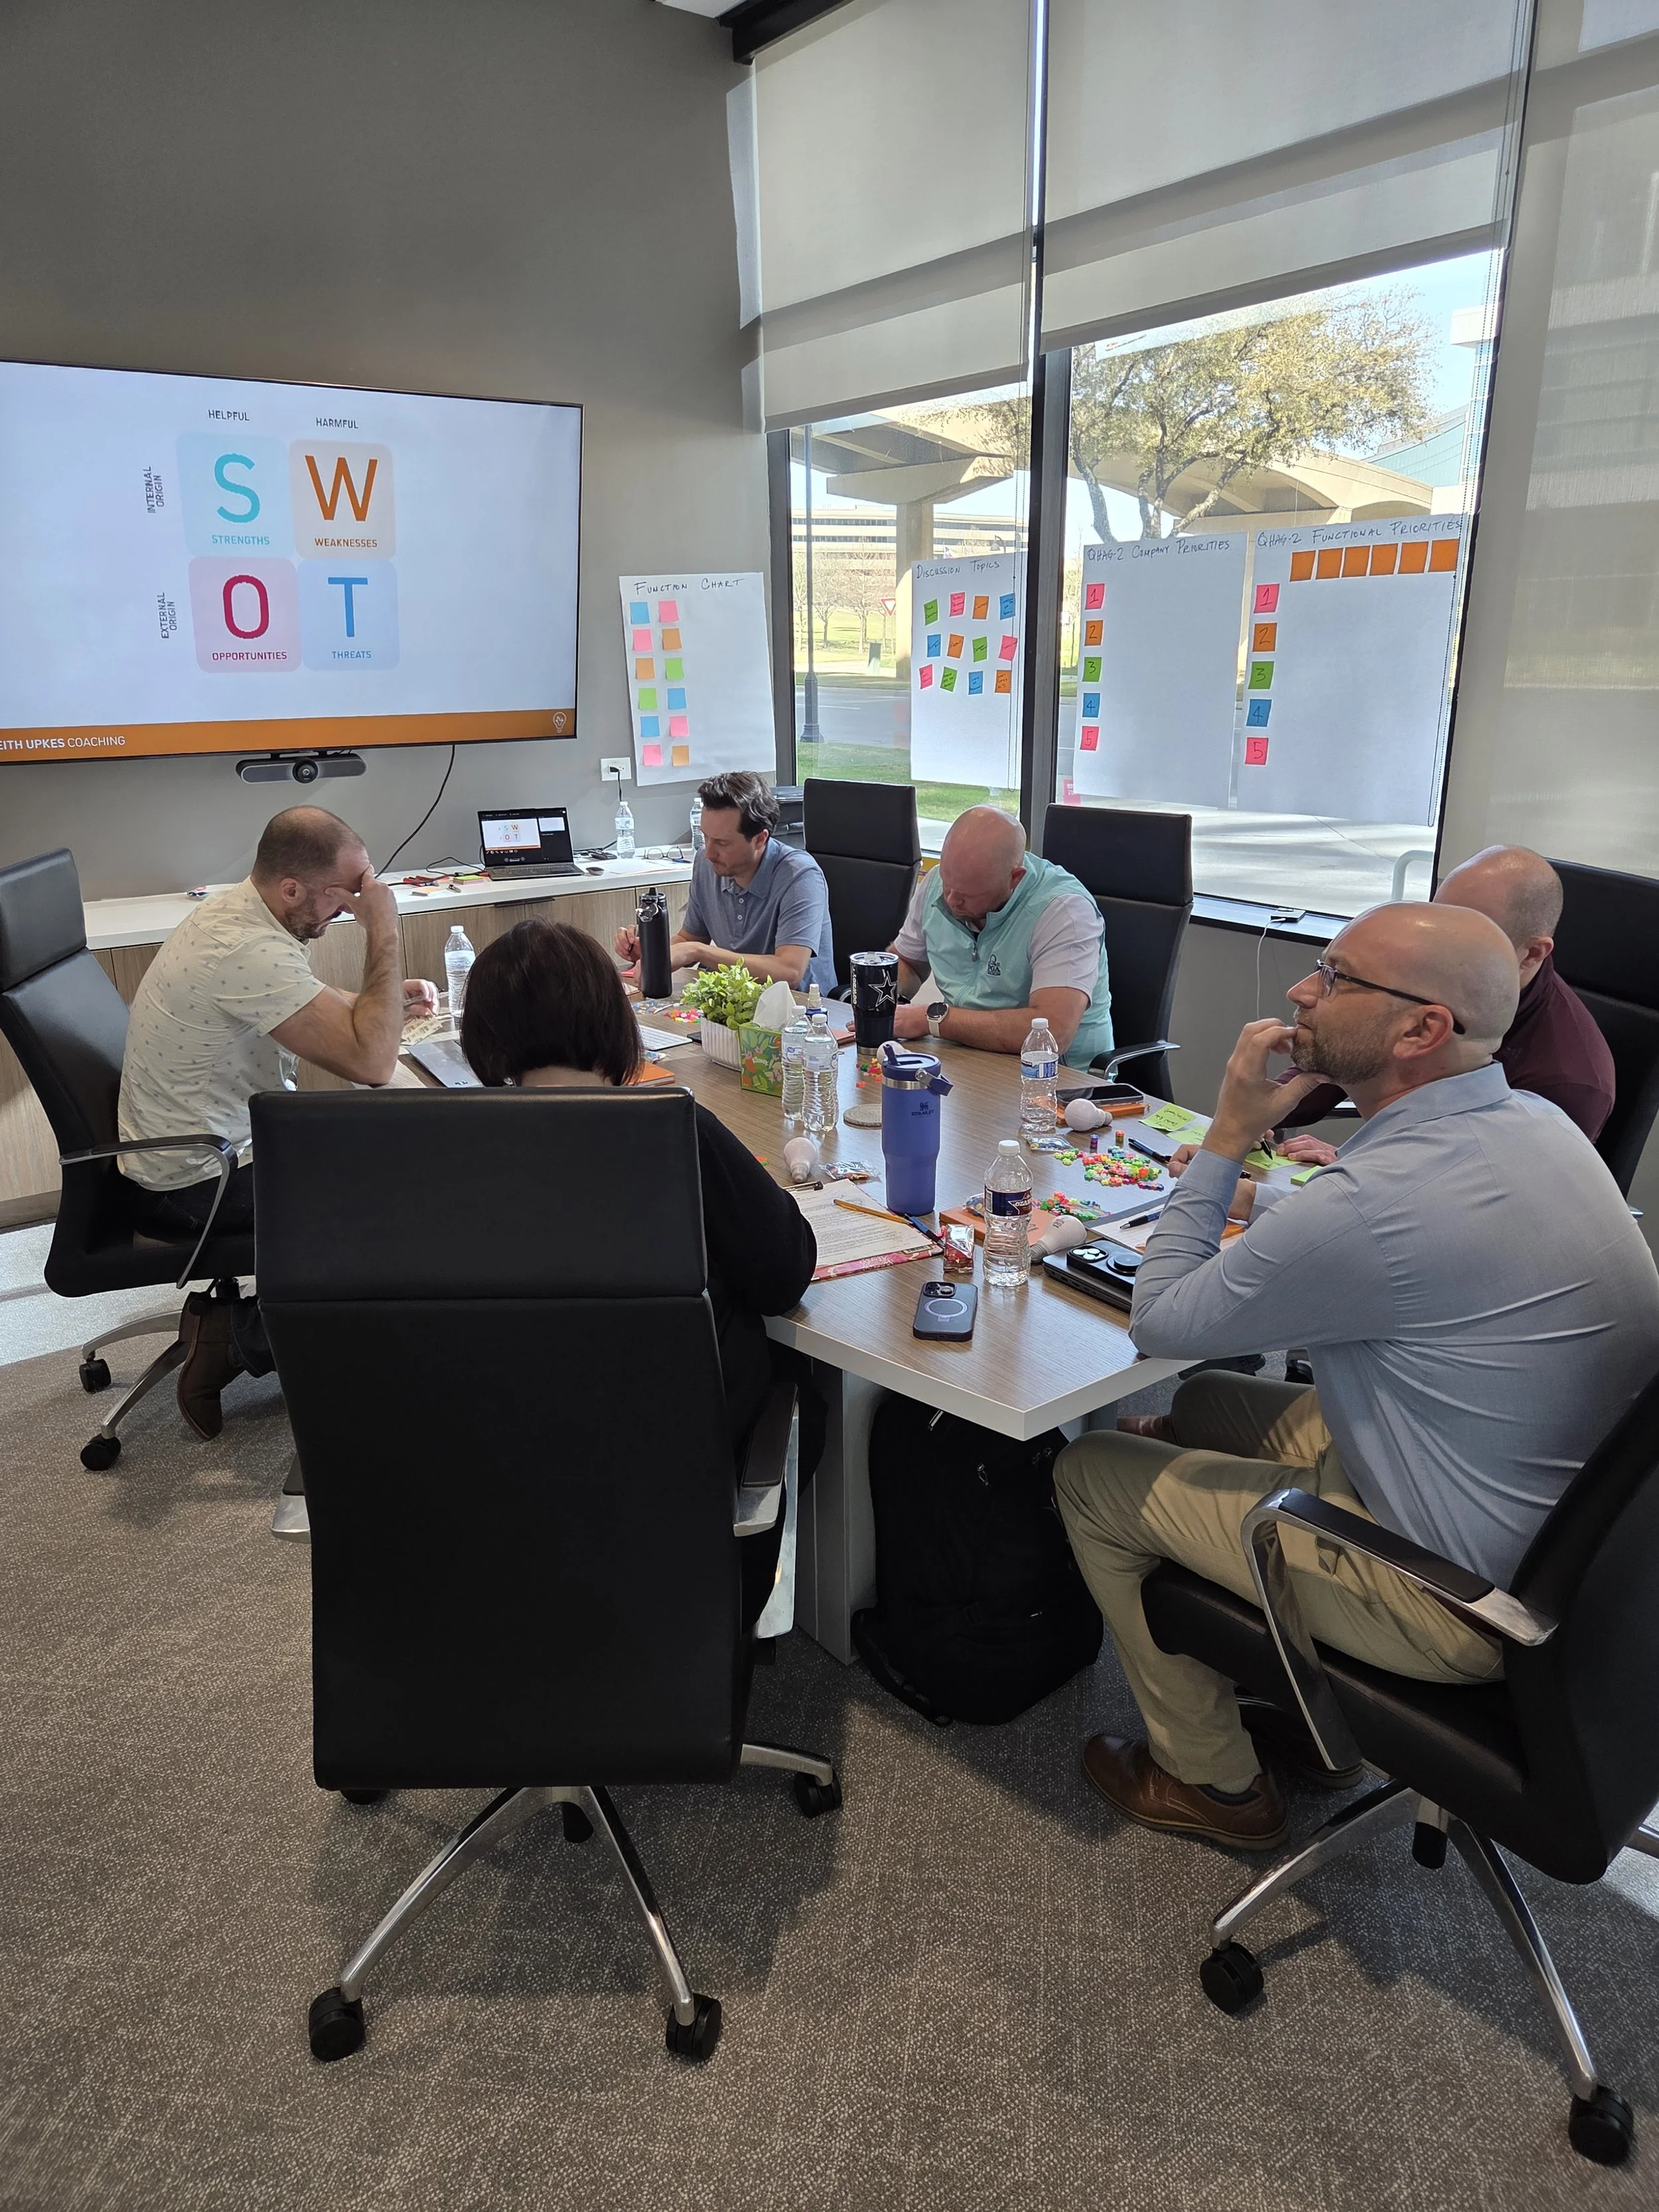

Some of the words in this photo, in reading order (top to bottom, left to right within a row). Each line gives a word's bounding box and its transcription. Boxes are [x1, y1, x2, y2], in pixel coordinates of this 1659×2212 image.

[208, 409, 250, 421] HELPFUL
[316, 417, 358, 429] HARMFUL
[143, 465, 155, 514] INTERNAL
[153, 475, 165, 508] ORIGIN
[214, 453, 260, 523] S
[305, 455, 378, 522] W
[212, 535, 270, 546] STRENGTHS
[1312, 528, 1382, 544] FUNCTIONAL
[1390, 520, 1461, 536] PRIORITIES
[315, 538, 378, 548] WEAKNESSES
[1131, 544, 1170, 559] COMPANY
[1176, 538, 1230, 555] PRIORITIES
[634, 581, 687, 595] FUNCTION
[701, 577, 745, 590] CHART
[1089, 589, 1099, 605] 1
[1260, 587, 1273, 607] 1
[157, 592, 169, 638] EXTERNAL
[167, 601, 177, 630] ORIGIN
[223, 574, 269, 639] O
[328, 577, 368, 637] T
[1088, 625, 1097, 639] 2
[1259, 627, 1271, 645] 2
[212, 652, 287, 660] OPPORTUNITIES
[332, 650, 372, 659] THREATS
[1088, 661, 1096, 674] 3
[1256, 668, 1266, 682] 3
[1086, 700, 1096, 715] 4
[1252, 705, 1263, 723] 4
[26, 738, 65, 749] UPKES
[67, 736, 125, 748] COACHING
[1084, 730, 1093, 747] 5
[1254, 741, 1263, 759] 5
